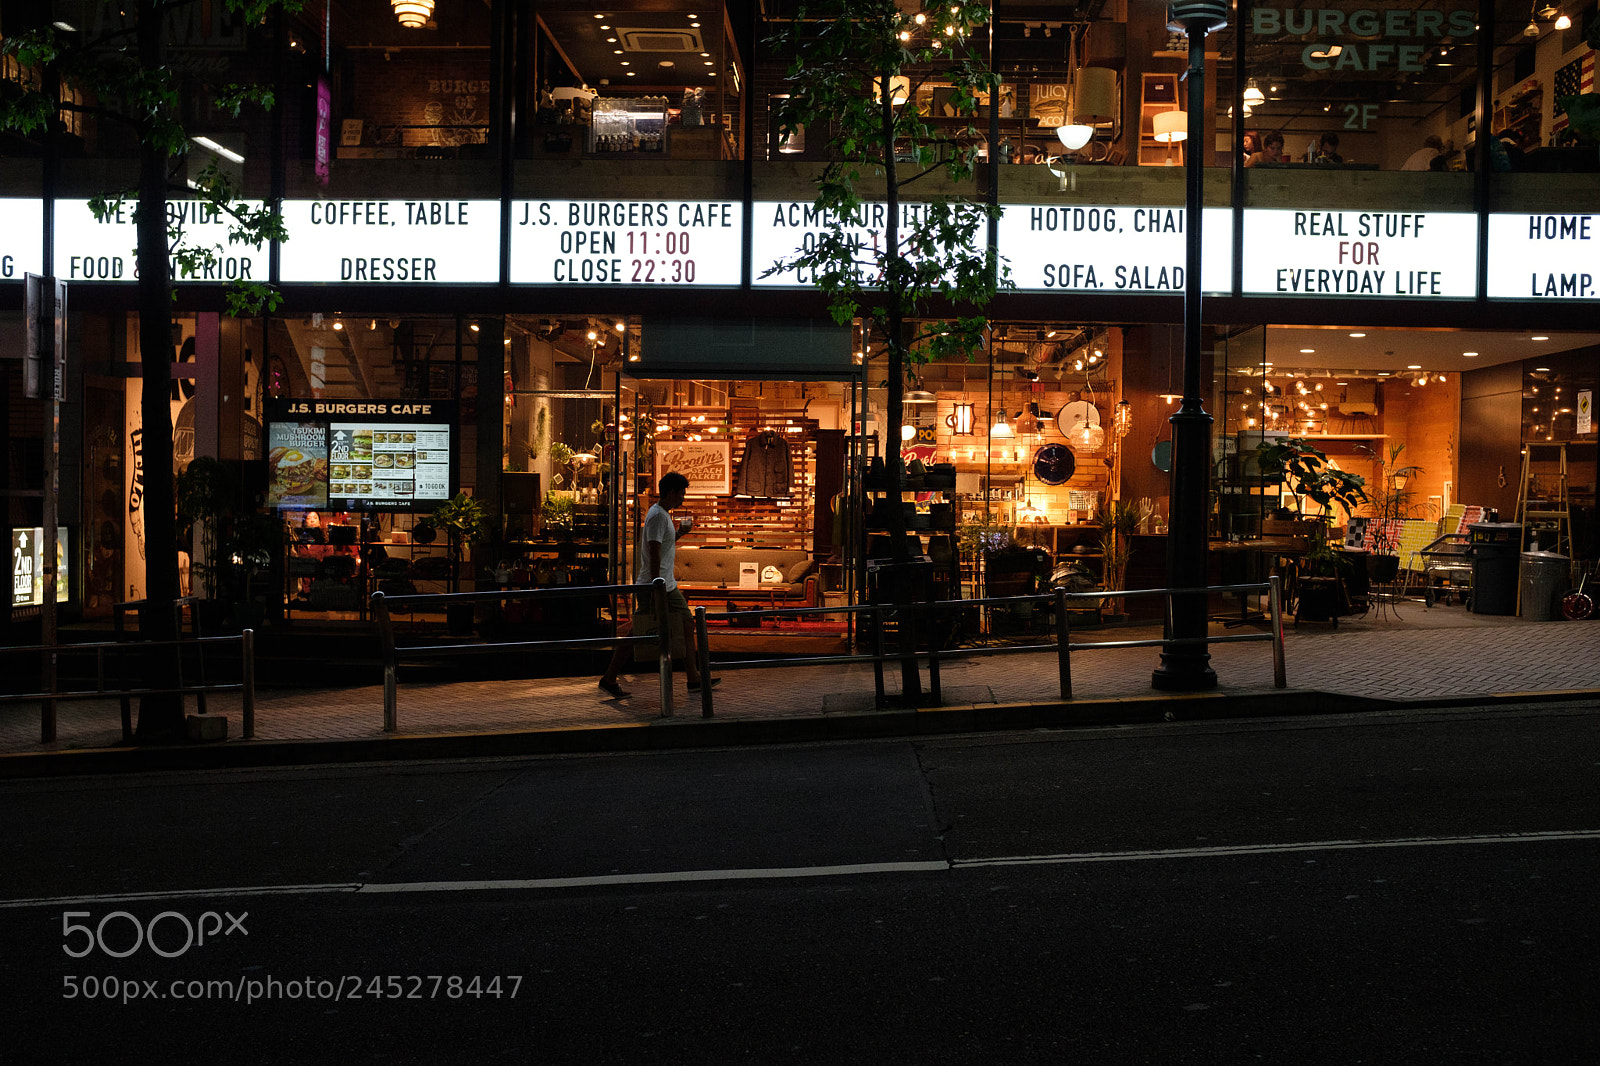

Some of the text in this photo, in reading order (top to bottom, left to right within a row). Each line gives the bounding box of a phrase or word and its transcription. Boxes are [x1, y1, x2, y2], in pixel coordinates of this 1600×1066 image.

[1252, 8, 1477, 37] BURGERS
[1301, 43, 1425, 72] CAFE
[1036, 85, 1067, 102] JUICY
[1035, 115, 1069, 126] ACON
[1343, 104, 1380, 130] 2F
[98, 202, 224, 224] WE OVIDE
[311, 202, 469, 227] COFFEE, TABLE
[519, 203, 732, 227] J.S. BURGERS CAFE
[773, 203, 833, 228] ACME
[1031, 207, 1185, 234] HOTDOG, CHAI
[1295, 212, 1425, 238] REAL STUFF
[1529, 215, 1592, 240] HOME
[561, 231, 690, 255] OPEN 11:00
[804, 232, 859, 256] OPN
[1338, 241, 1380, 265] FOR
[71, 257, 123, 279] FOOD
[165, 257, 252, 280] NERIOR
[341, 257, 437, 281] DRESSER
[554, 259, 695, 283] CLOSE 22:30
[1115, 265, 1184, 290] SALAD
[1276, 269, 1442, 295] EVERYDAY LIFE
[288, 403, 432, 415] J.S. BURGERS CAFE
[276, 433, 326, 441] MUSHROOM
[292, 427, 326, 435] TSUKIMI
[14, 547, 32, 576] 2ND
[14, 574, 32, 589] FLOOR
